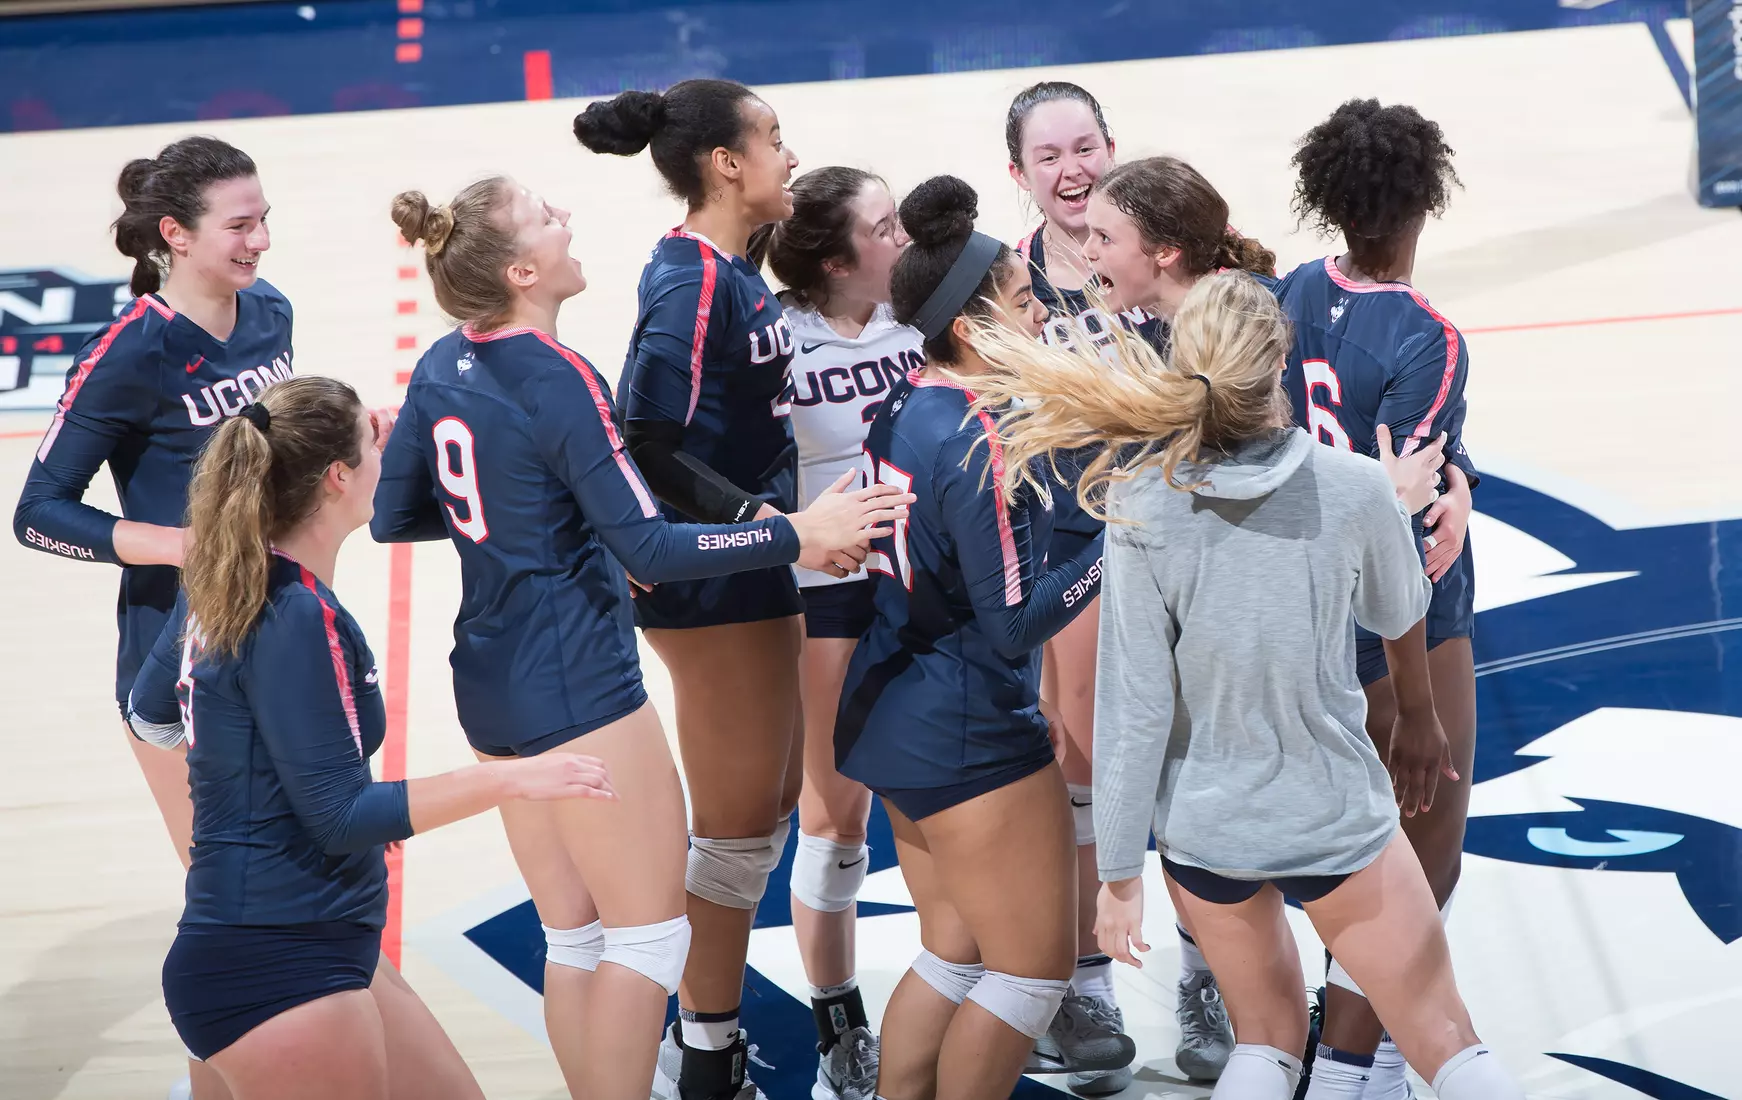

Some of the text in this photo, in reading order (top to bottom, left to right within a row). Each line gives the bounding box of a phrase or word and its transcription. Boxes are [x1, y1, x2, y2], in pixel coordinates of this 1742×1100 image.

[1302, 358, 1354, 453] 6
[431, 415, 489, 545] 9
[25, 526, 95, 560] HUSKIES
[697, 527, 772, 551] HUSKIES
[1062, 556, 1104, 608] USKIES
